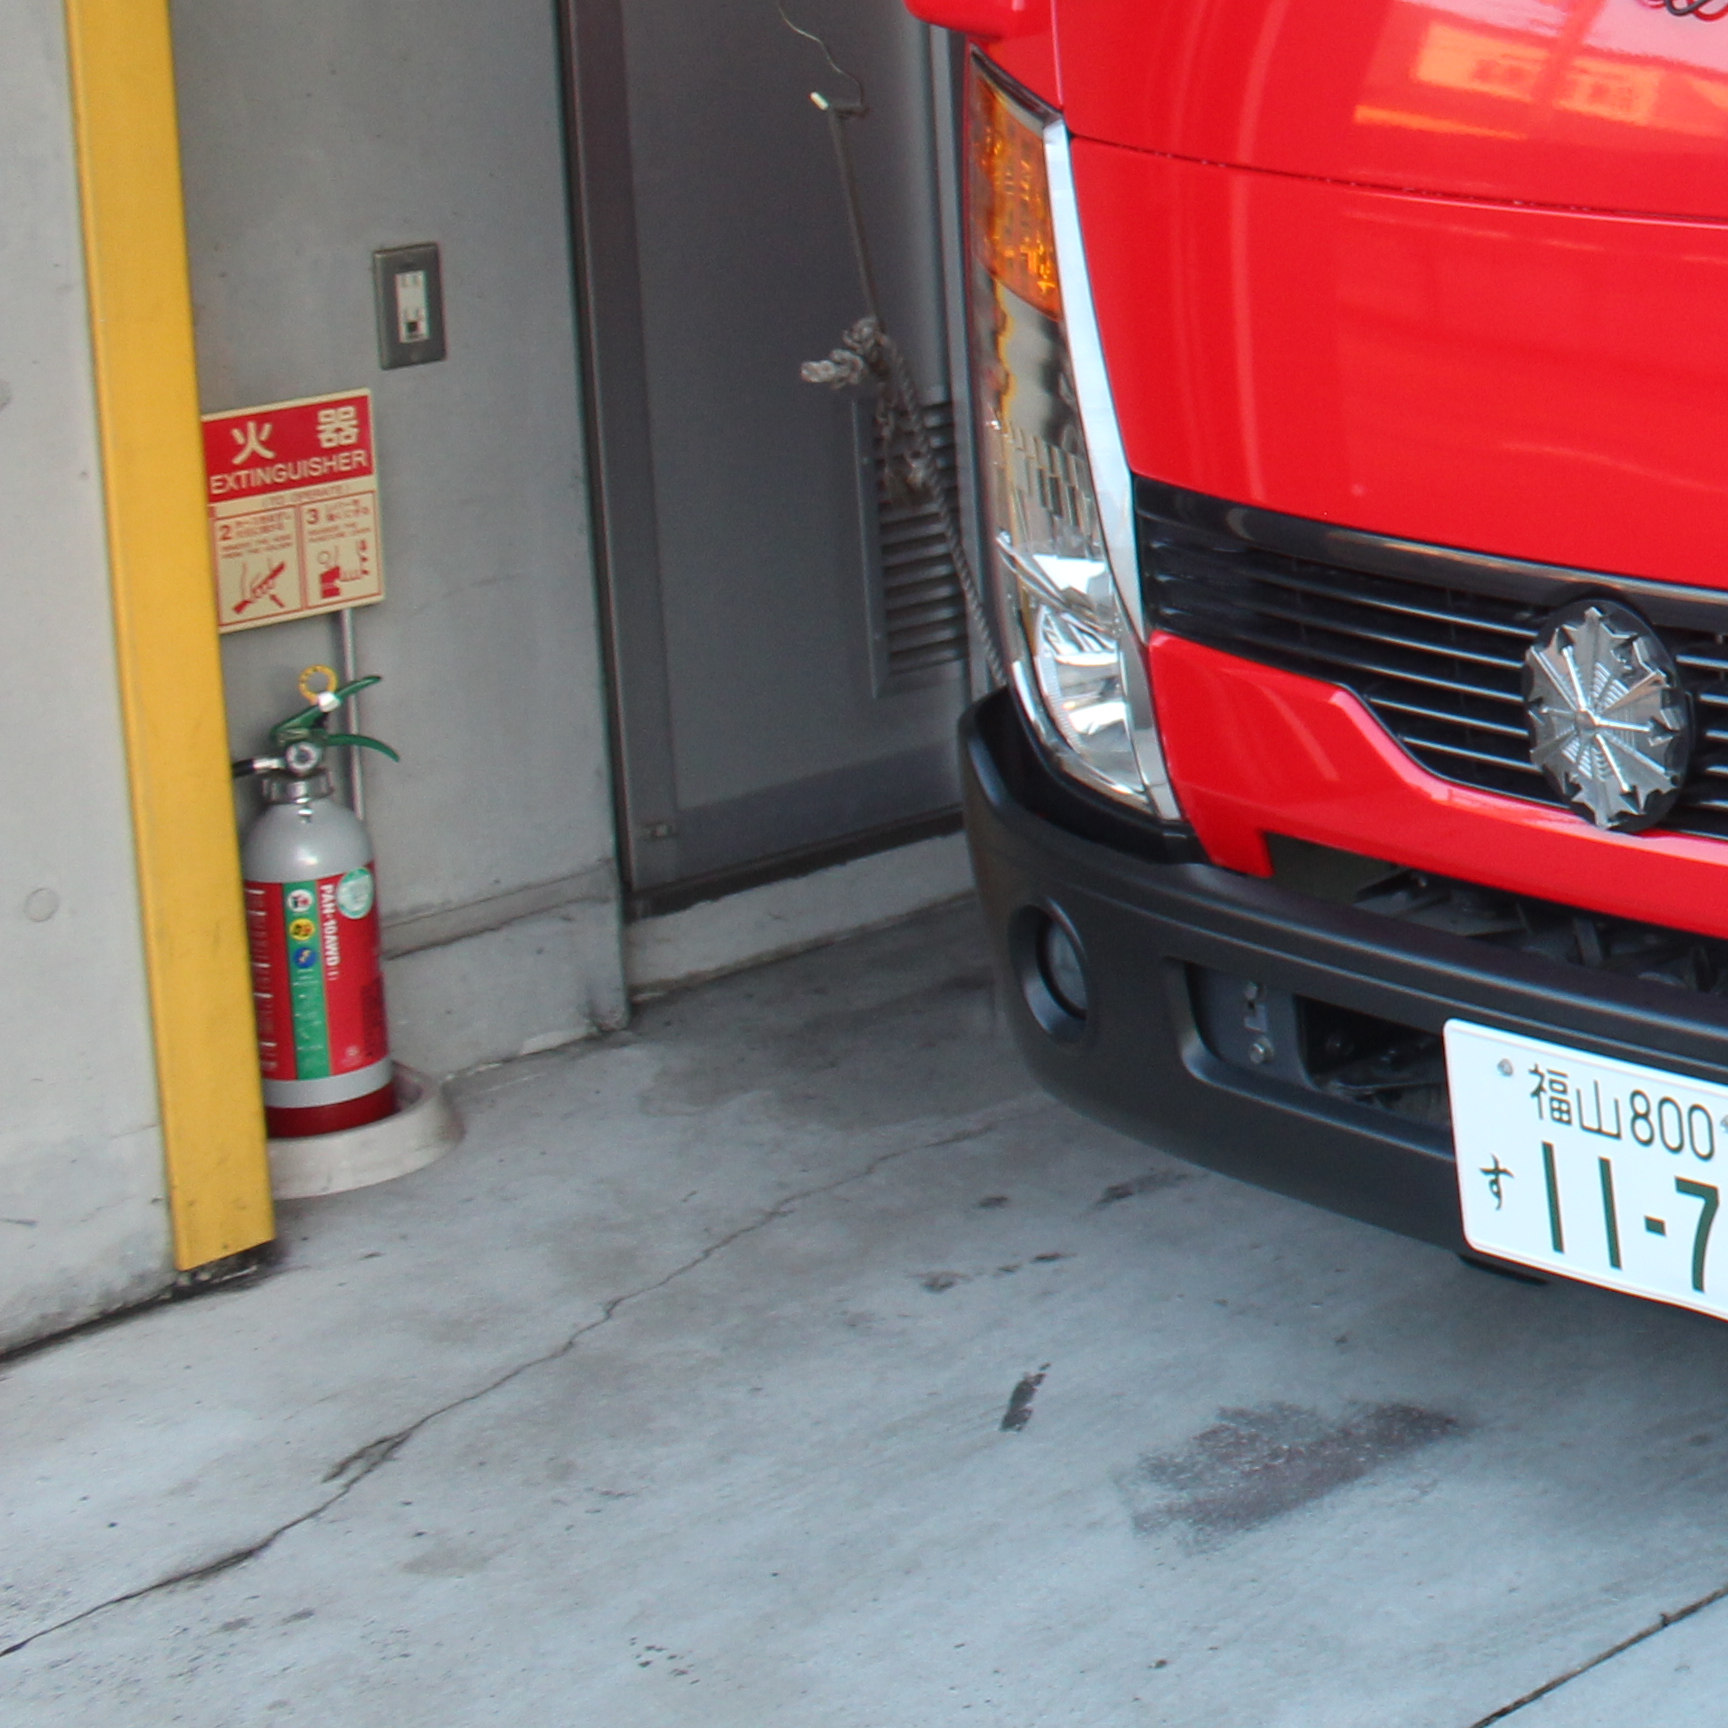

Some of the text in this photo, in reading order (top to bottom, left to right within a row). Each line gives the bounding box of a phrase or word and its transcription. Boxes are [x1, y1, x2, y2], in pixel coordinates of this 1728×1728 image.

[210, 449, 368, 495] EXTINGUISHER
[306, 508, 320, 525] 3
[219, 524, 233, 541] 2
[1480, 1153, 1515, 1211] す
